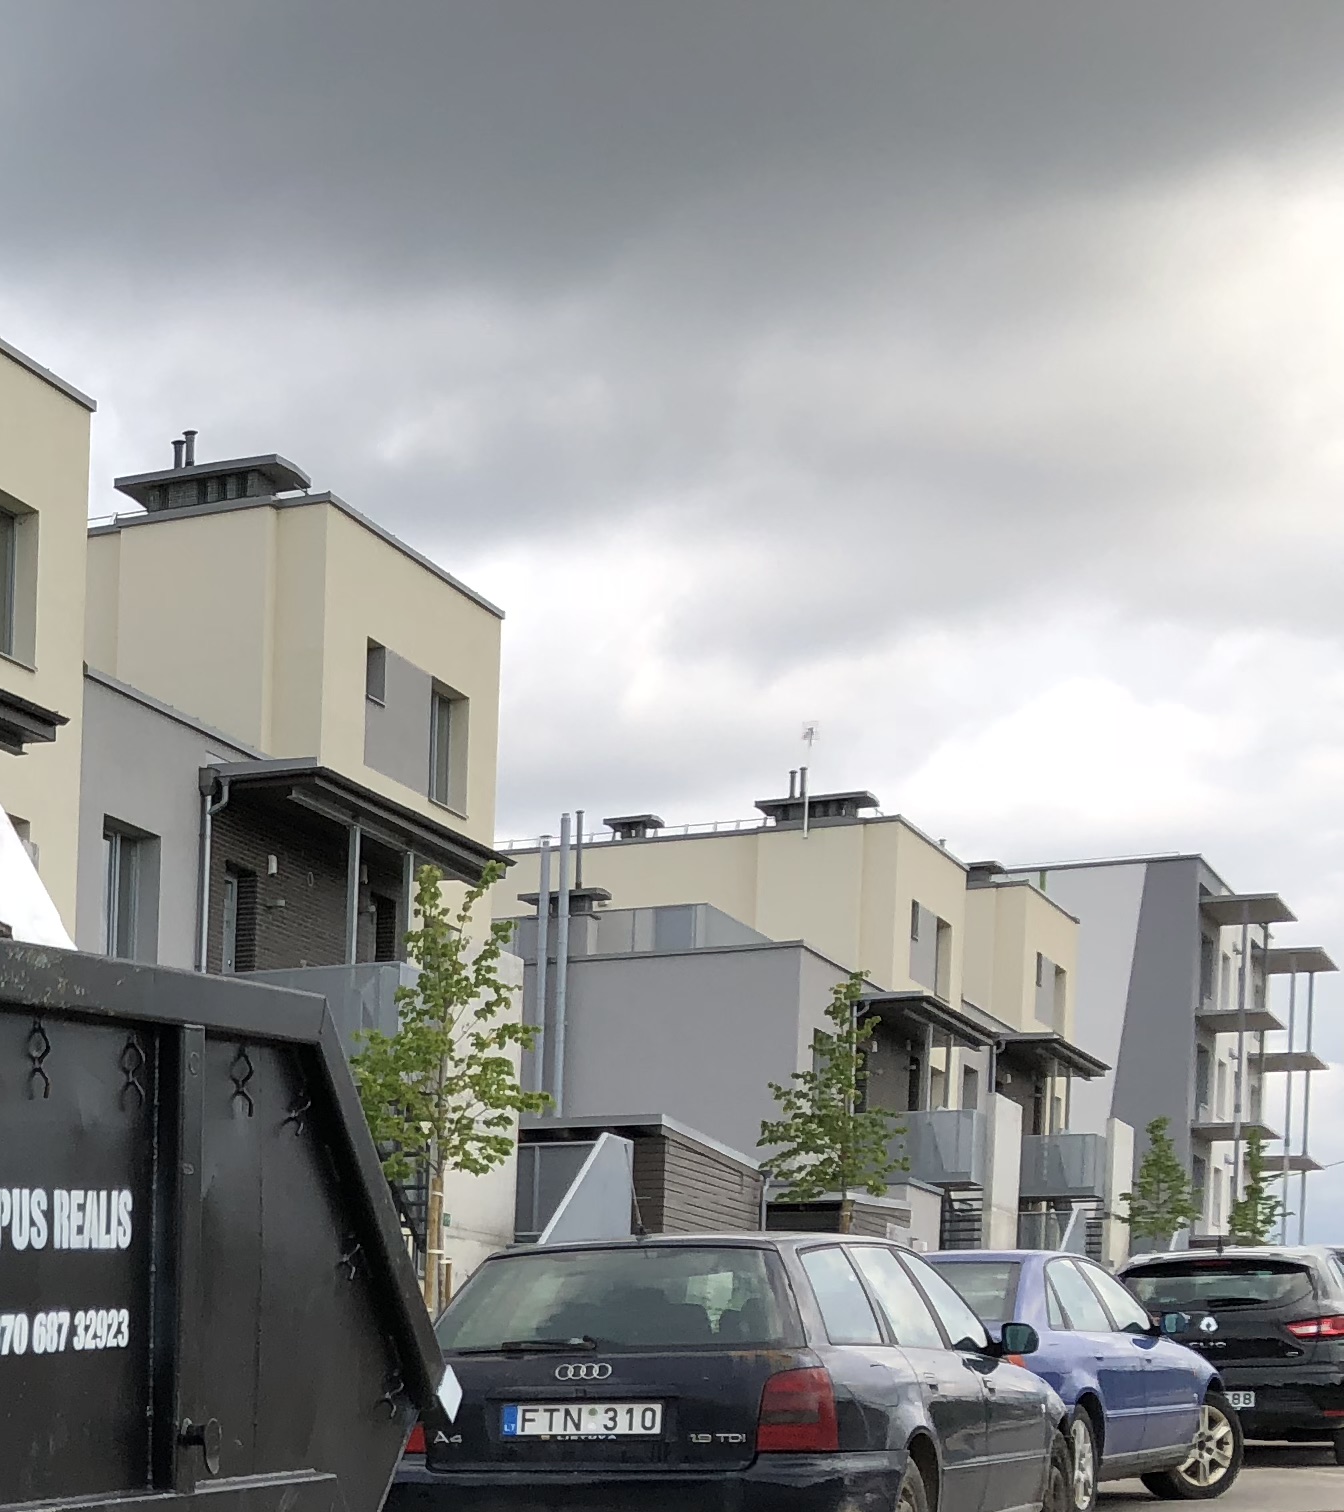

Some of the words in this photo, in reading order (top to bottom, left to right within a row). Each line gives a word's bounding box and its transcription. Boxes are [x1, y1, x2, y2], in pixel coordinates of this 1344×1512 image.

[53, 1189, 133, 1250] REALIS
[32, 1310, 71, 1355] 687
[73, 1308, 130, 1351] 32923
[503, 1423, 516, 1432] LT
[520, 1407, 583, 1433] FTN
[602, 1406, 658, 1432] 310
[433, 1430, 463, 1444] A4
[715, 1433, 747, 1443] TDI
